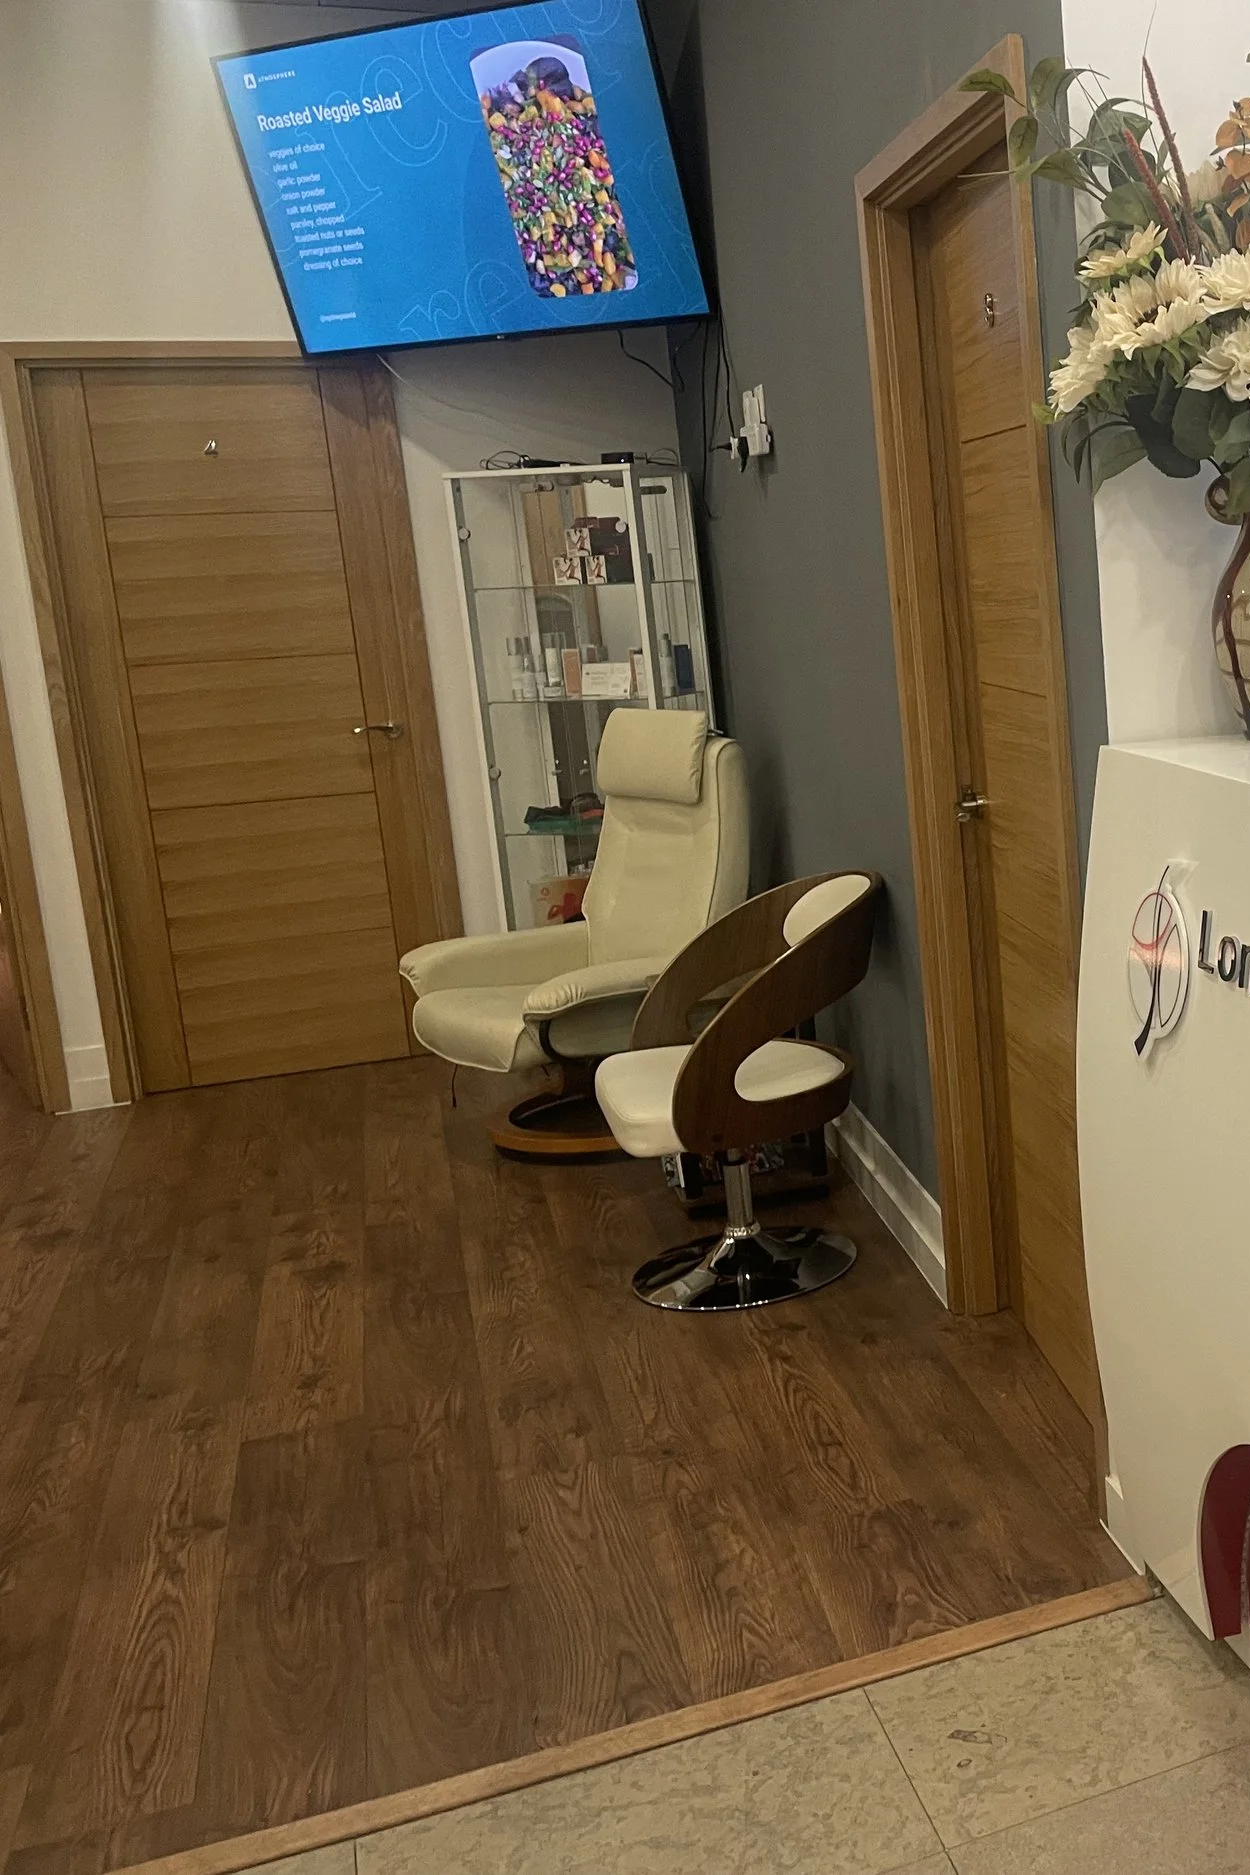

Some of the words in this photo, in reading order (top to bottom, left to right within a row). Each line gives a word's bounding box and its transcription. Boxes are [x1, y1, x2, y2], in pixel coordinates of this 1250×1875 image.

[257, 107, 312, 131] Roasted
[312, 100, 361, 123] Veggie
[362, 91, 402, 114] Salad
[269, 147, 294, 159] veggies
[294, 144, 302, 154] of
[302, 143, 325, 153] choice
[272, 164, 288, 173] olive
[289, 160, 298, 170] oil
[277, 177, 296, 188] garlic
[296, 173, 320, 186] powder
[280, 192, 300, 201] onion
[301, 188, 325, 200] powder
[286, 206, 299, 215] salt
[299, 203, 312, 213] and
[313, 201, 336, 213] pepper
[315, 214, 345, 226] chopped
[320, 230, 336, 239] nuts
[335, 229, 343, 238] or
[343, 241, 364, 251] seeds
[332, 258, 340, 268] of
[340, 257, 363, 266] choice
